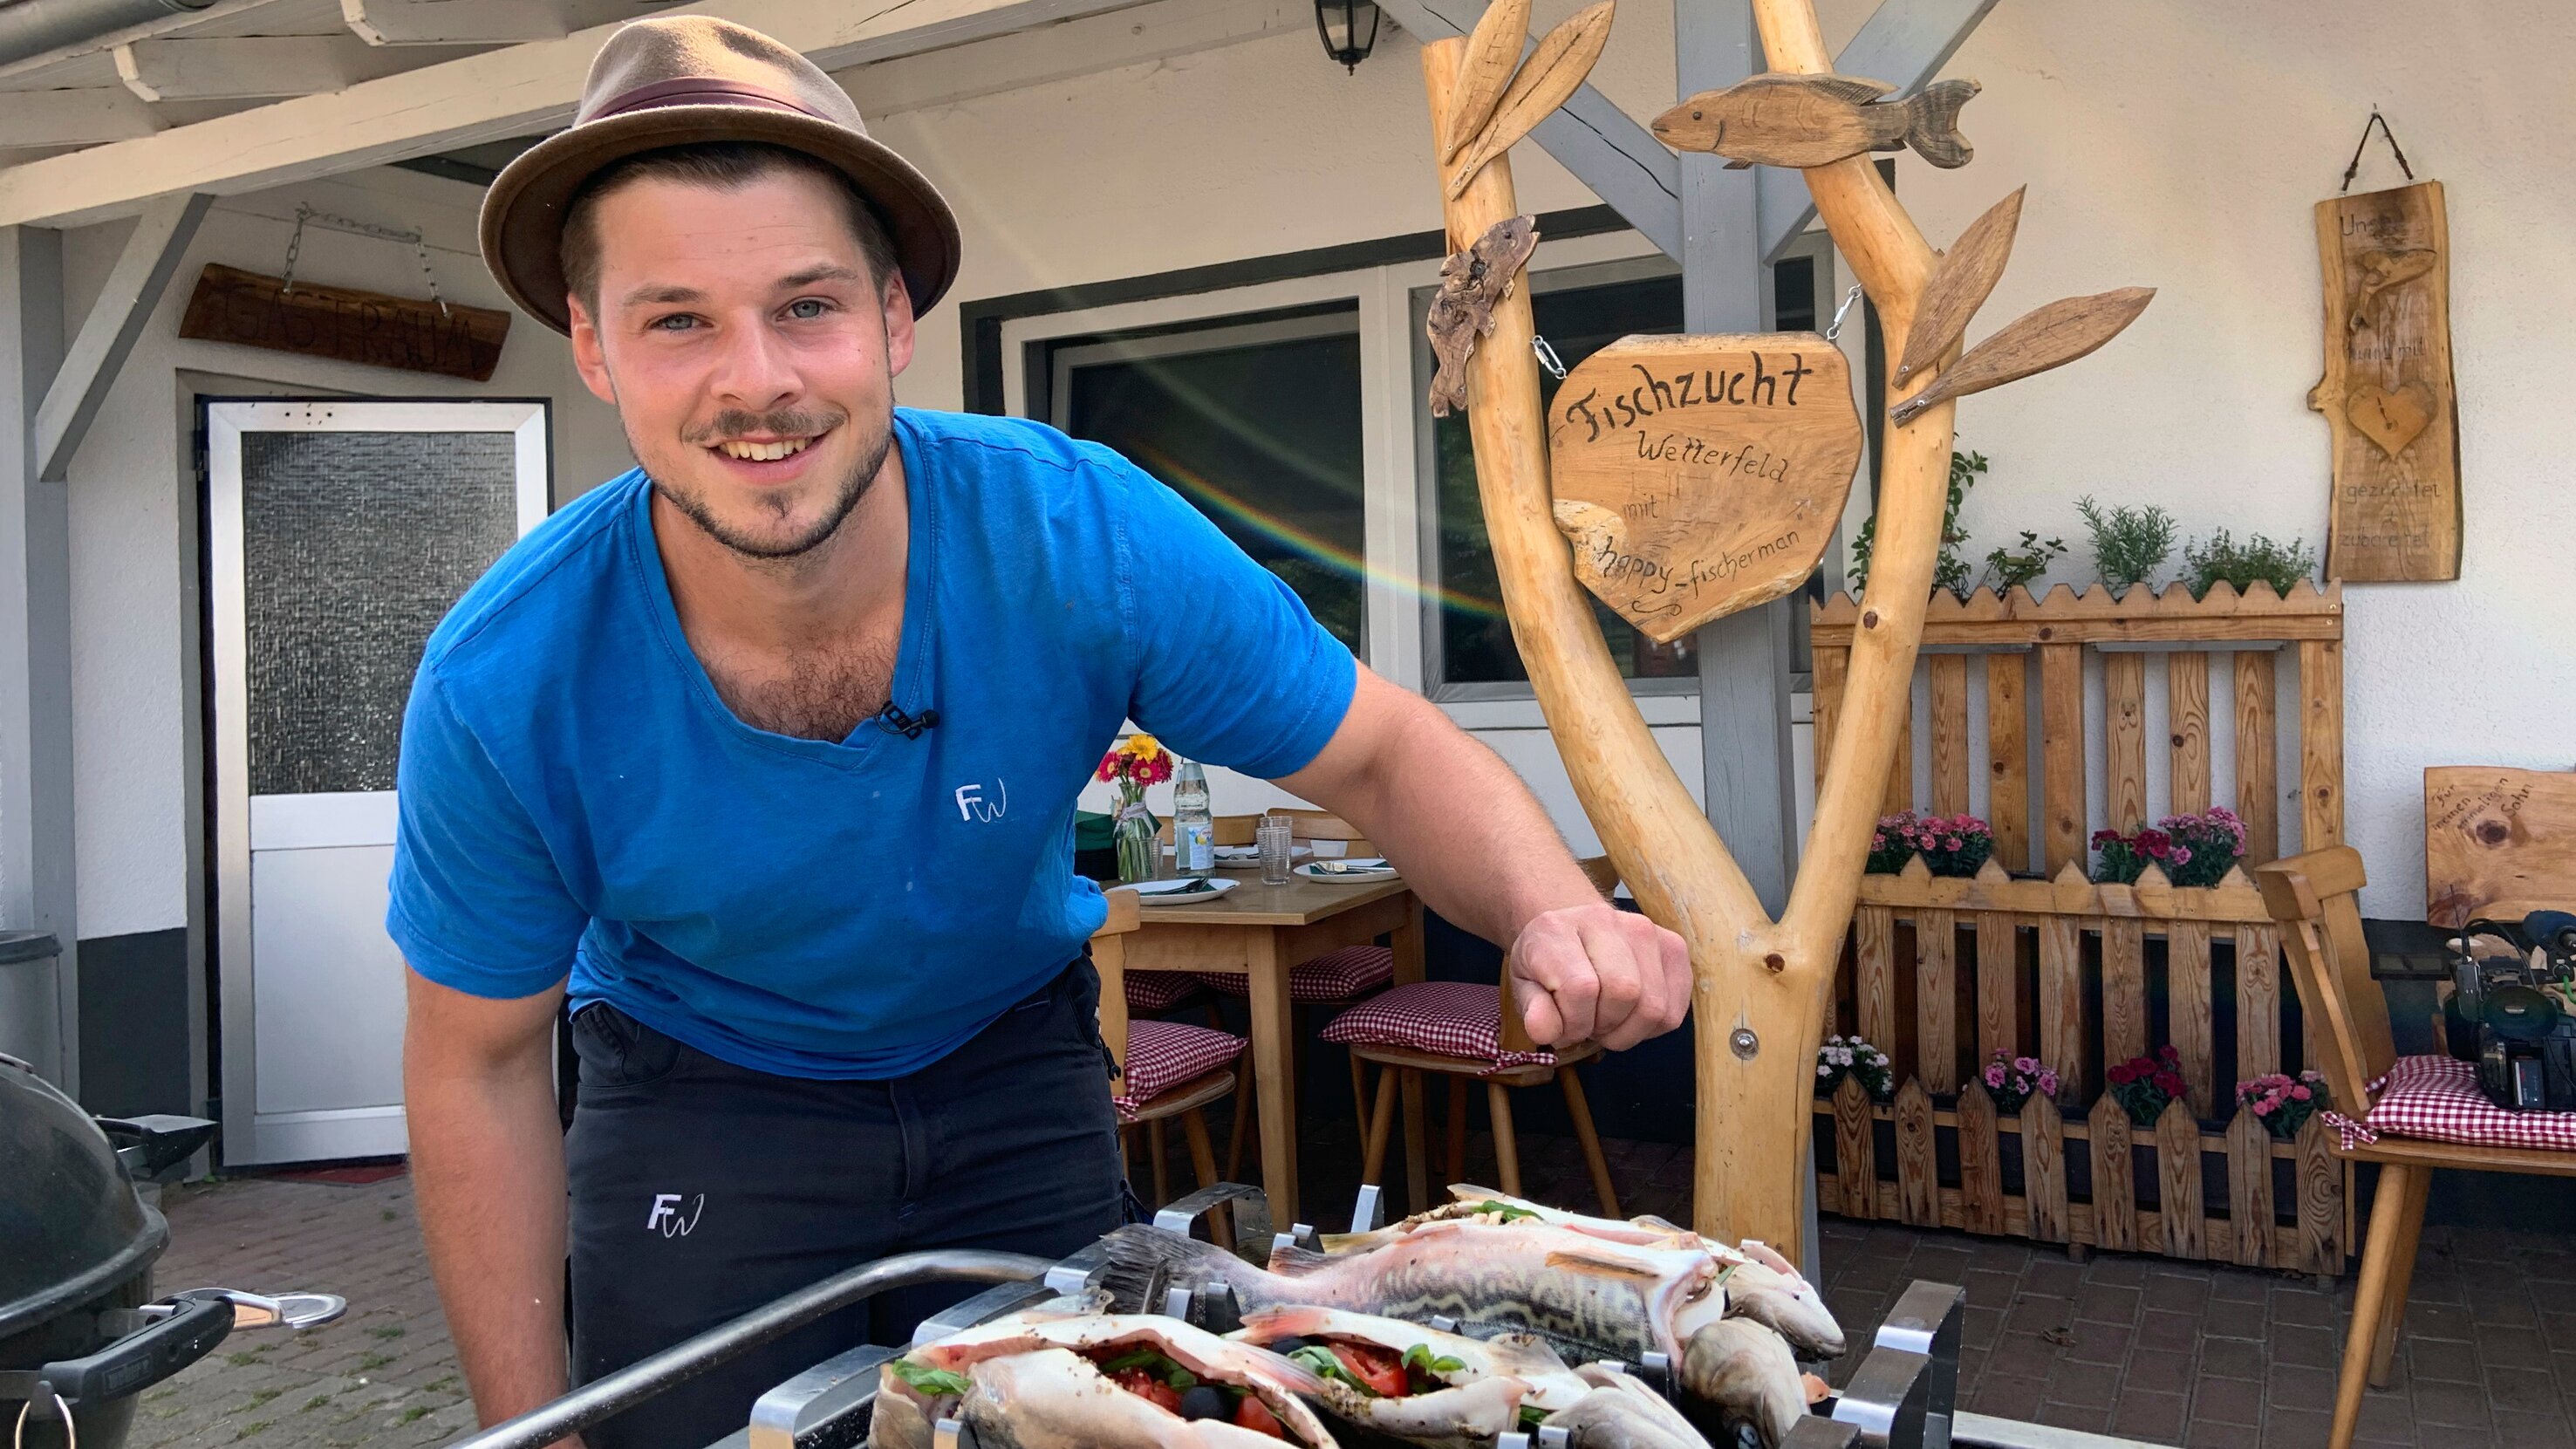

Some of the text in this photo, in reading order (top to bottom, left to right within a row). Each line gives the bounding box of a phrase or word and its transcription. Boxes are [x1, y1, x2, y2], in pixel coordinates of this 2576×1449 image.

[224, 284, 477, 372] GASTRAUM
[1566, 351, 1814, 442] Fischzucht
[1637, 431, 1787, 483] Wetterfeld
[1623, 493, 1658, 518] mit
[2347, 479, 2442, 503] gezctet
[955, 777, 1006, 823] FW
[2501, 784, 2533, 817] Sohn
[647, 1193, 704, 1238] FW
